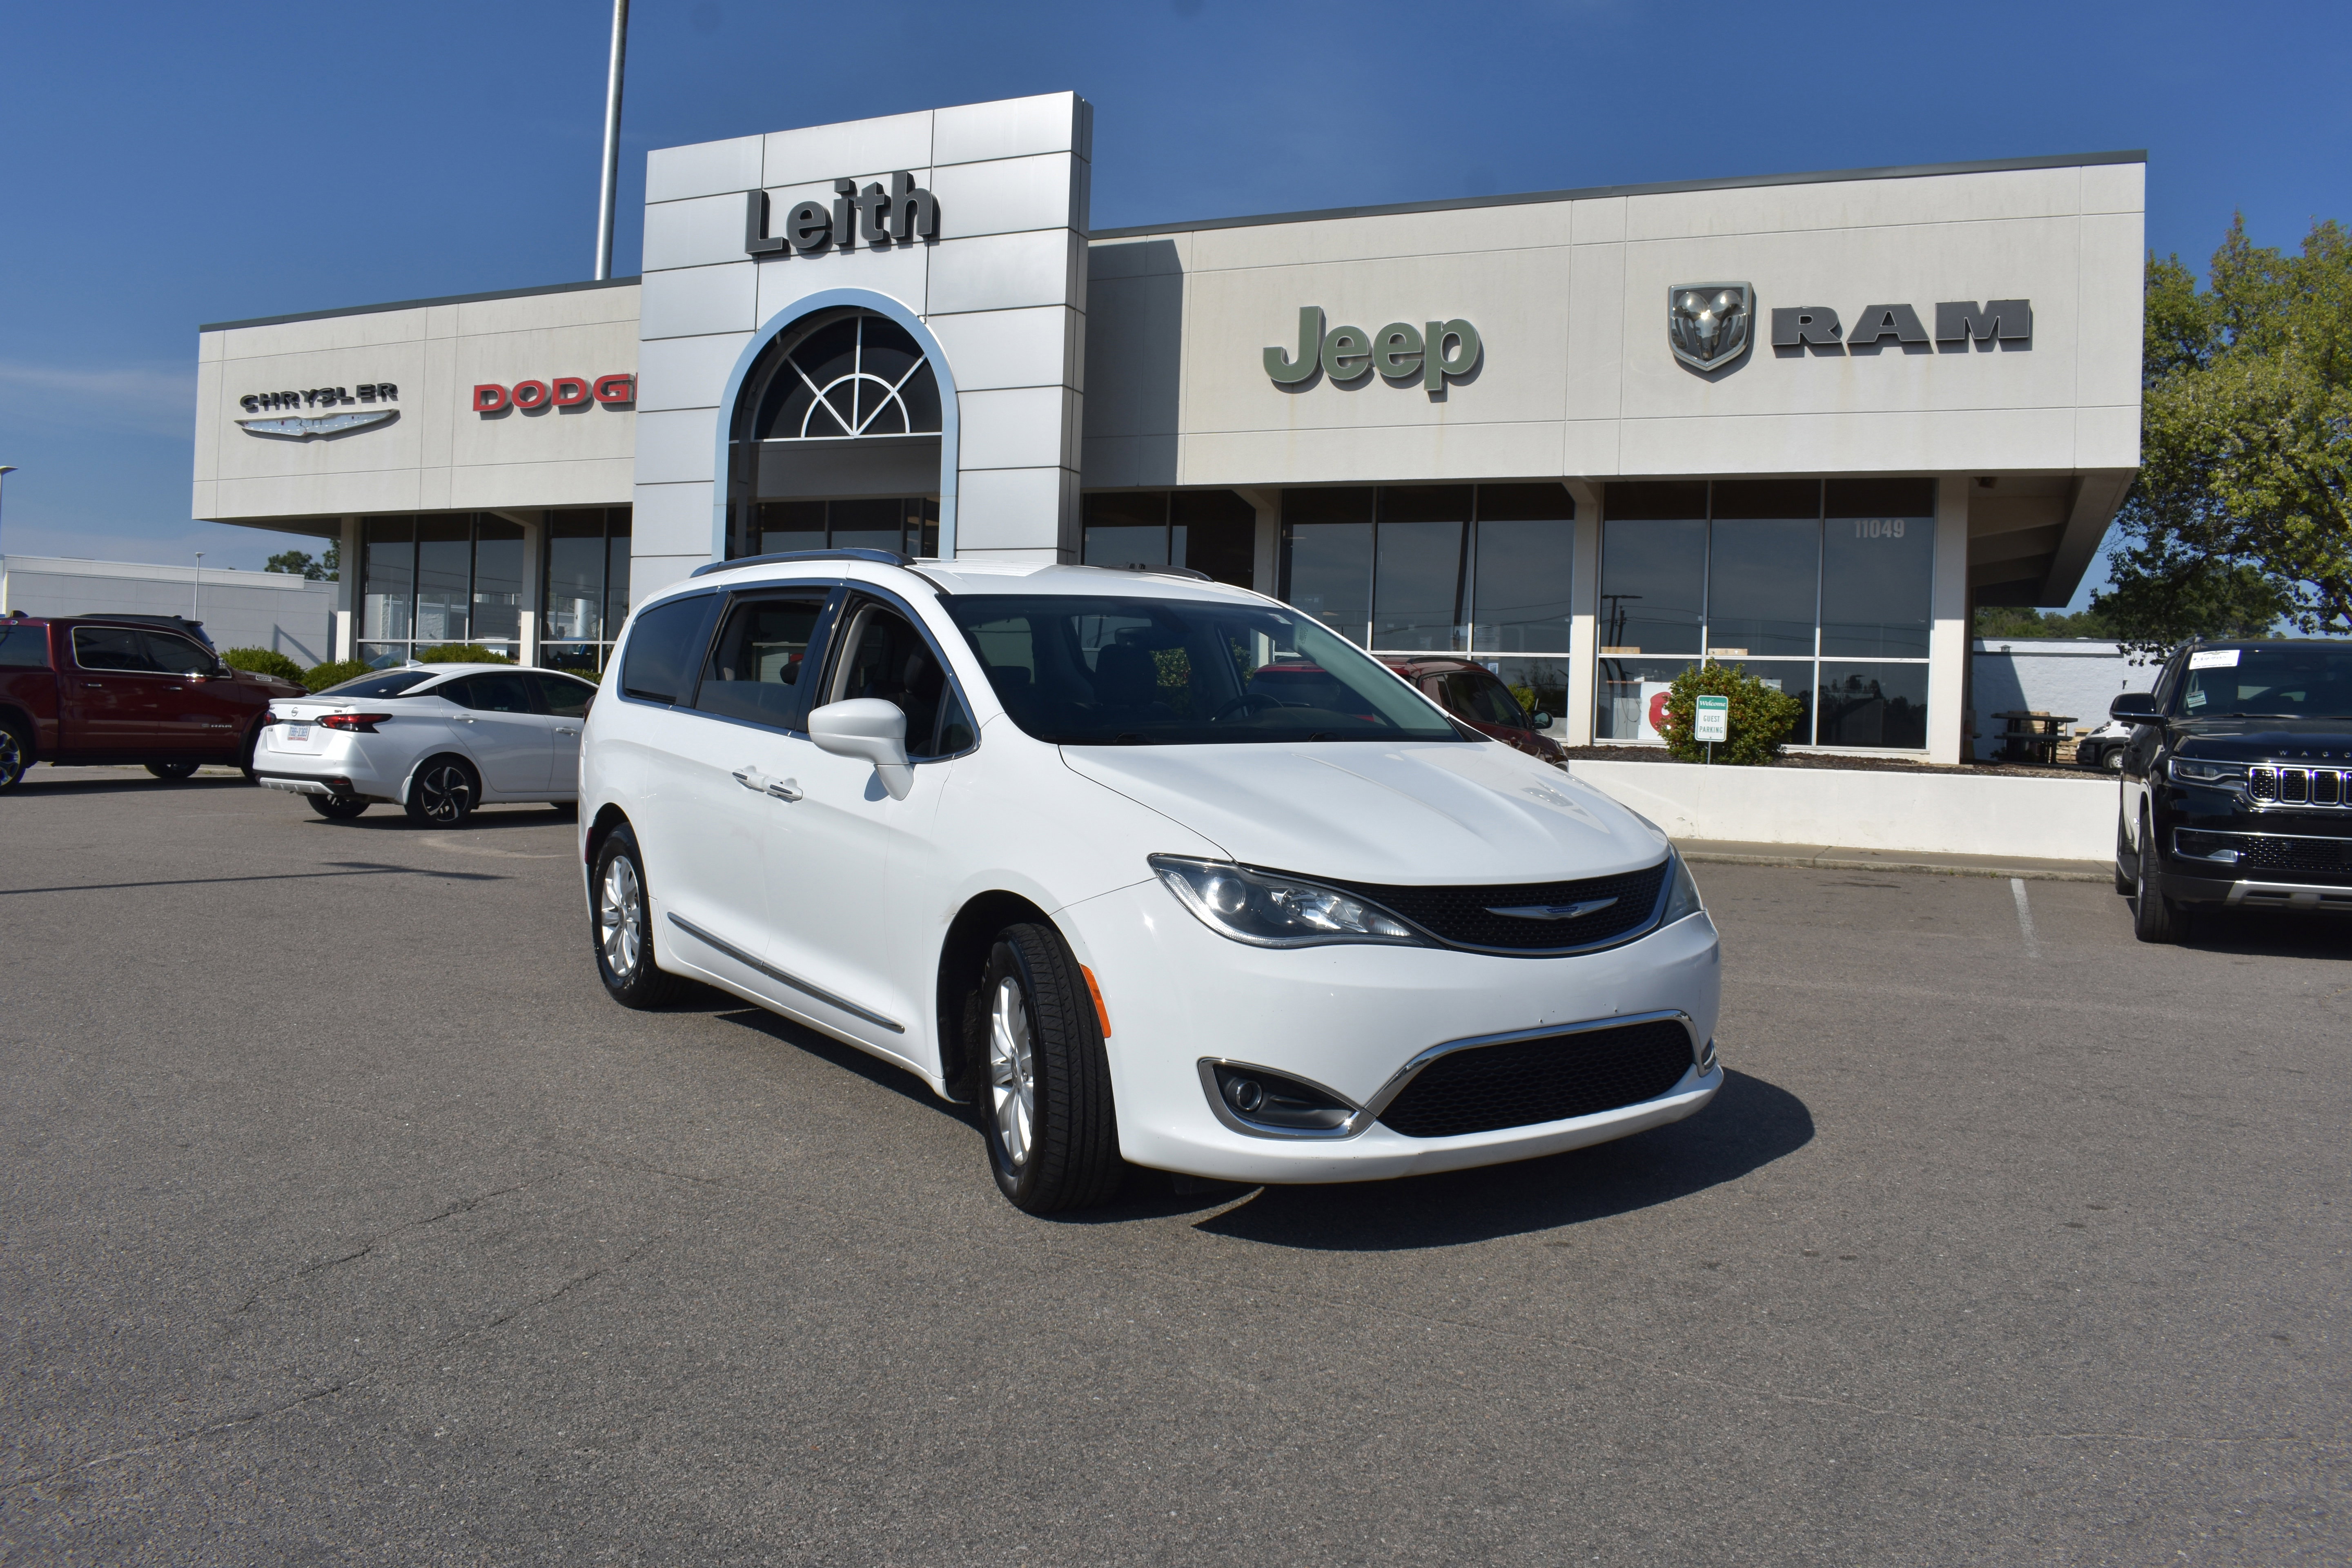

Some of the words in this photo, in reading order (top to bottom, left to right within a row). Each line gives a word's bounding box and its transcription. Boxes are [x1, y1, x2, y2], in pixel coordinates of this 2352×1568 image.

[744, 171, 940, 254] Leith
[1771, 299, 2031, 346] RAM
[1263, 305, 1481, 391] Jeep
[239, 383, 398, 409] CHRYSLER
[472, 372, 638, 412] DODG
[1854, 519, 1905, 538] 11049
